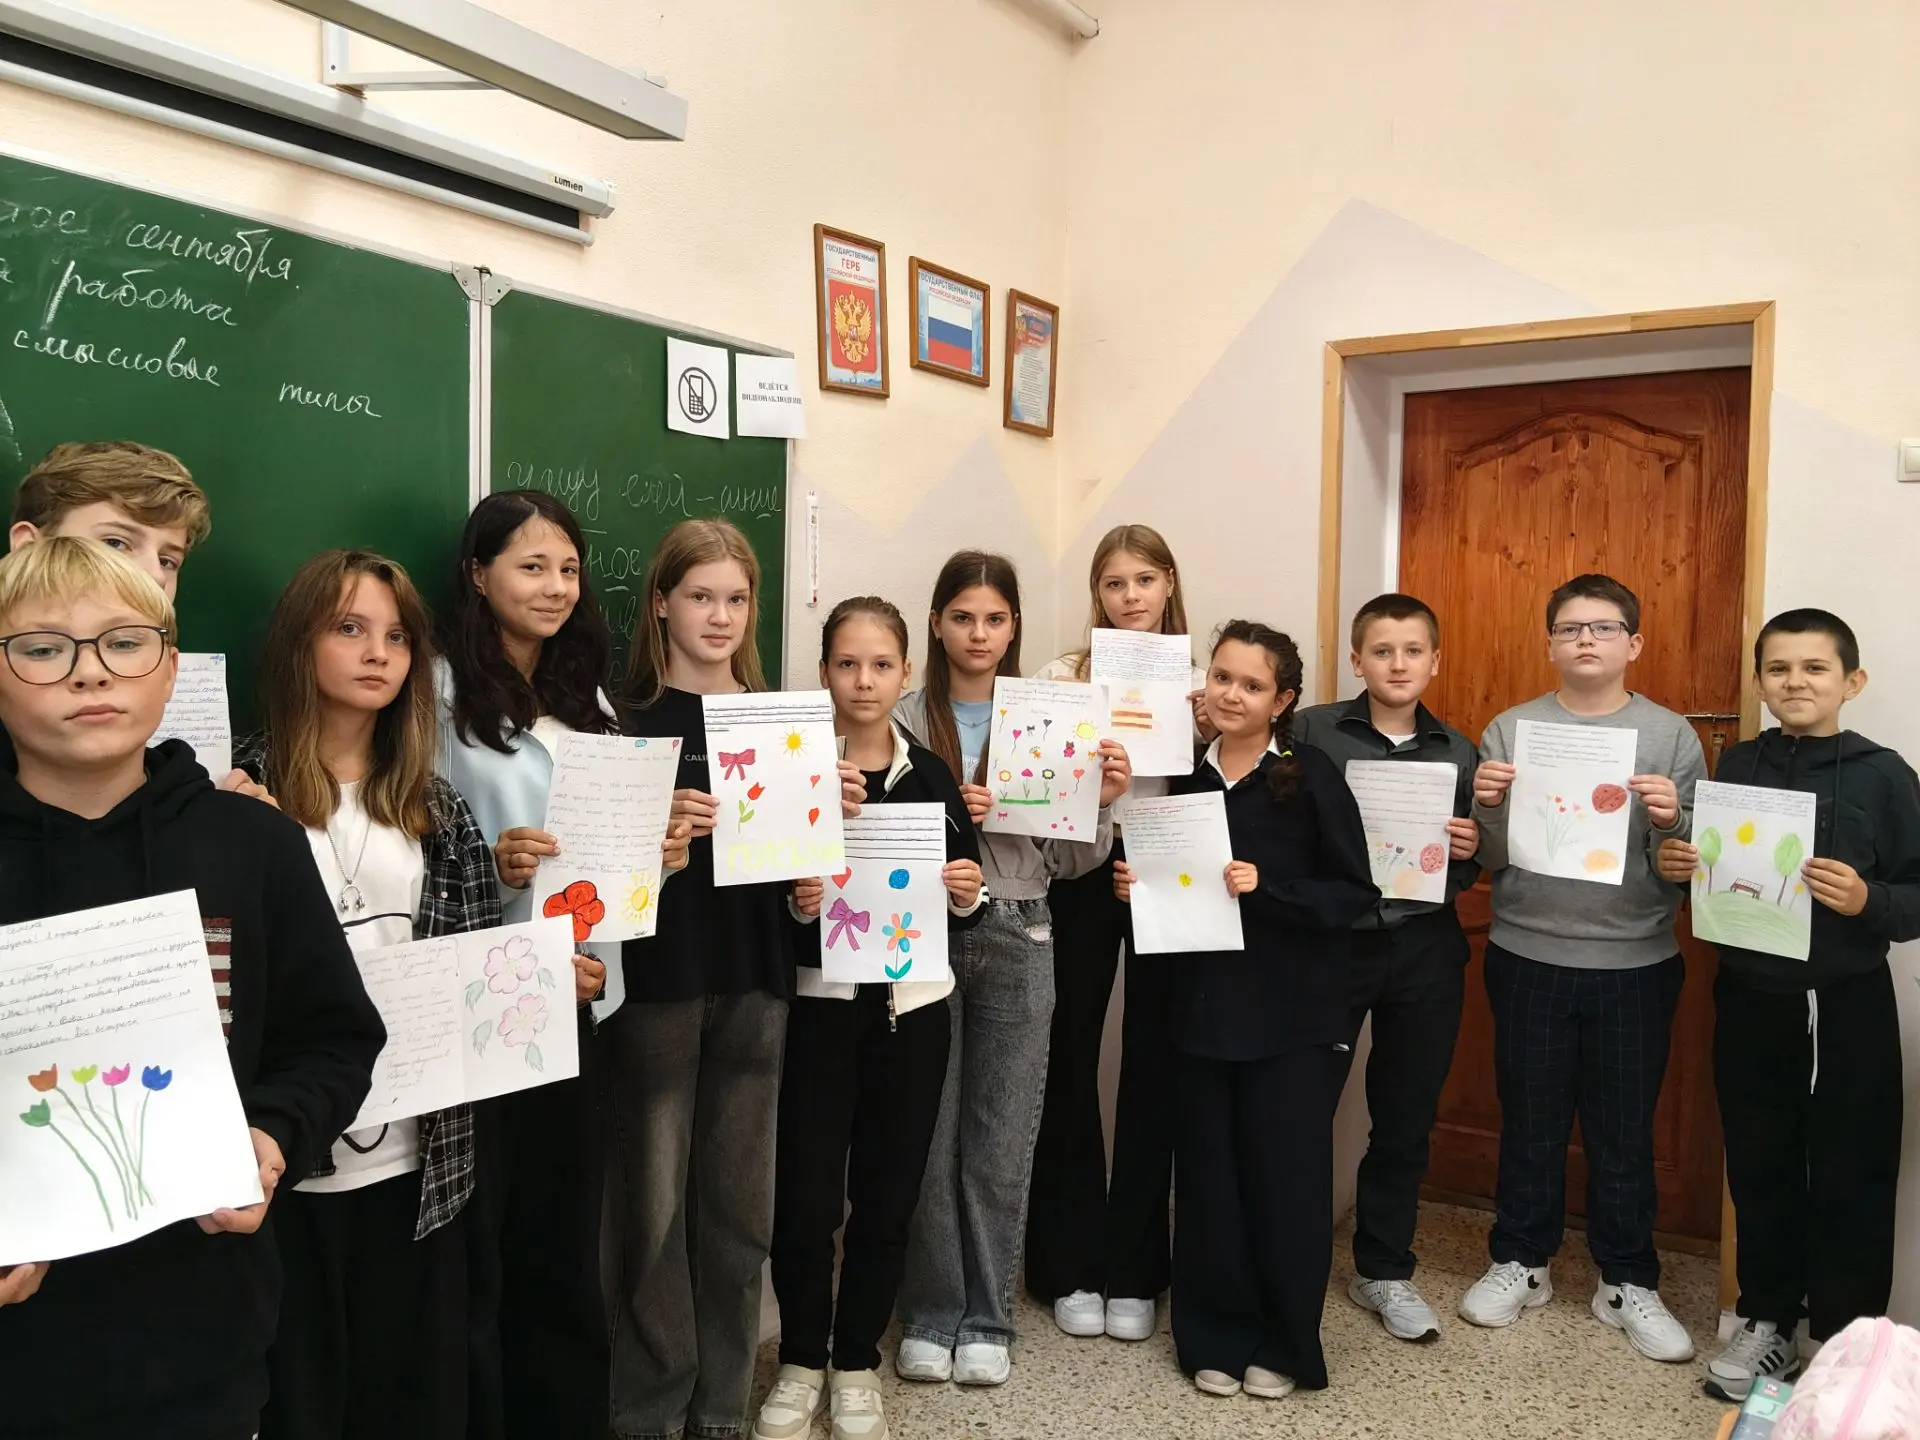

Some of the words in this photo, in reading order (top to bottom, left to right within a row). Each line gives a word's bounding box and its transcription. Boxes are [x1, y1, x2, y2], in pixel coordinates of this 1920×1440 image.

[826, 243, 876, 263] ГОСУДАРСТВЕННЫЙ
[841, 258, 861, 272] ГЕРБ
[41, 260, 237, 331] работа
[758, 381, 789, 392] ВЕДЁТСЯ
[279, 381, 382, 418] типы
[684, 754, 708, 762] CALI
